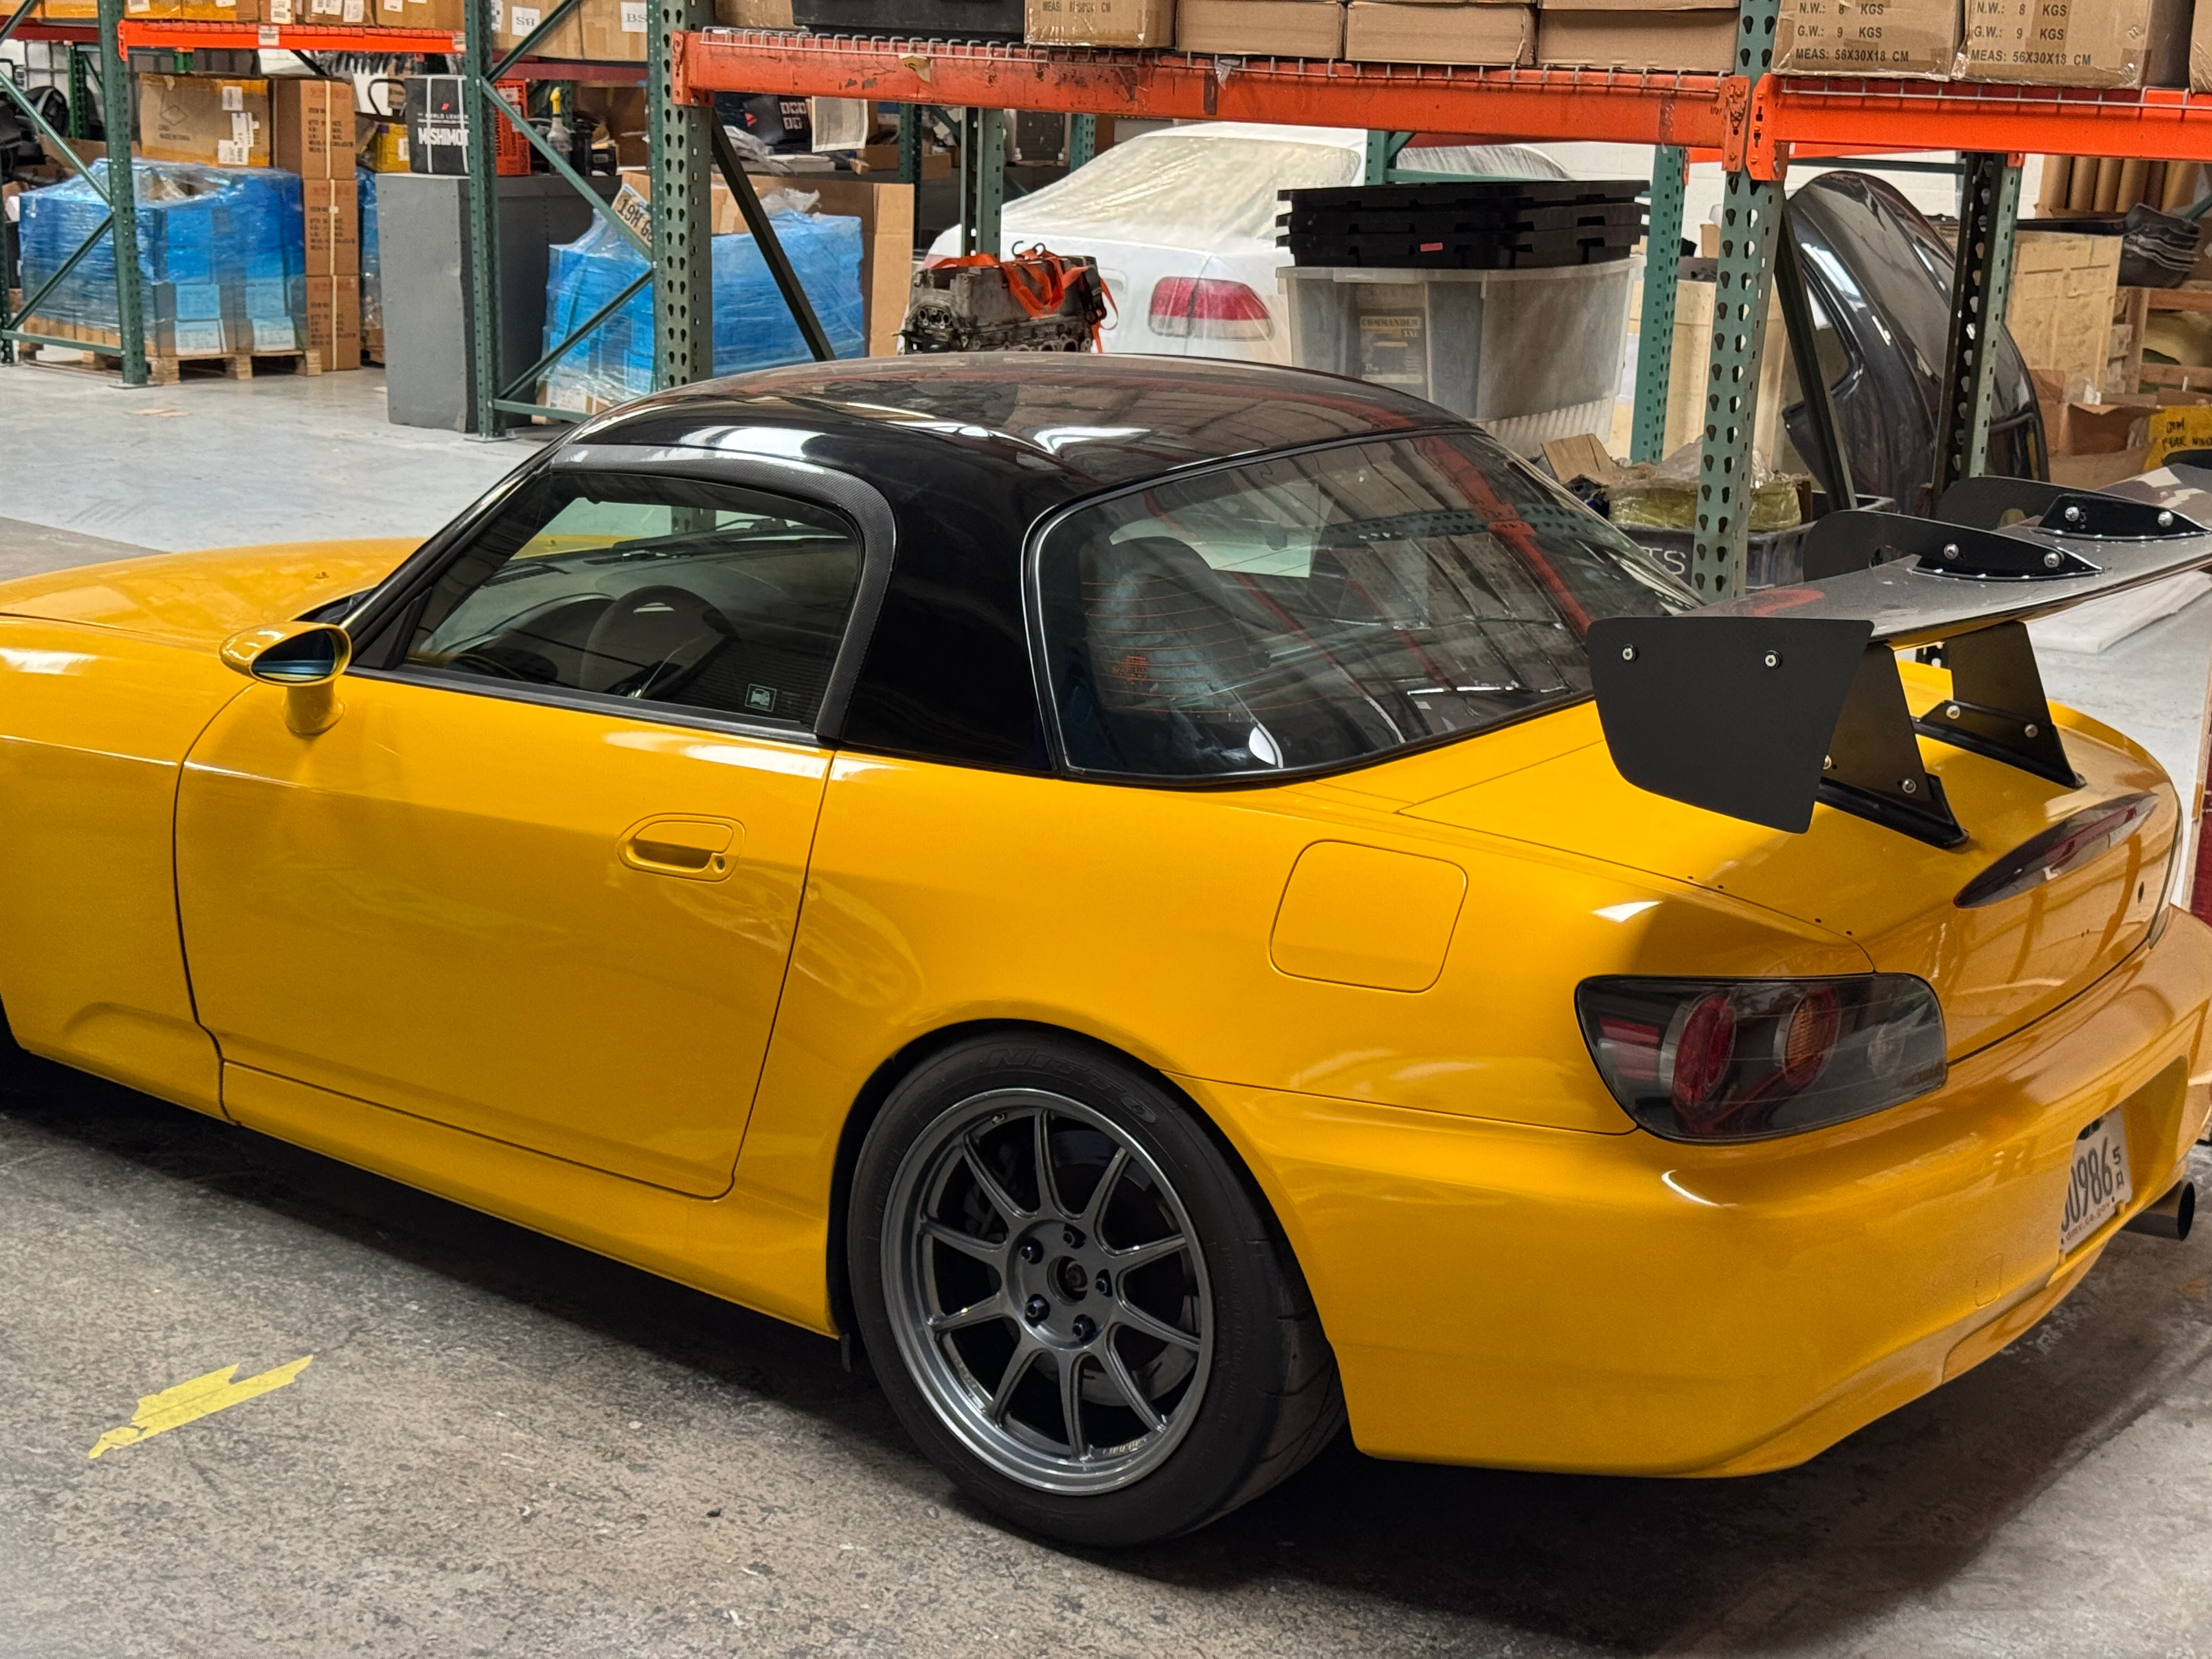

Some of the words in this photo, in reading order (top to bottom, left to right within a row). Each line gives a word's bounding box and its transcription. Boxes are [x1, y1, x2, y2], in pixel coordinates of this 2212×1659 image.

[1838, 4, 1844, 15] 8
[1860, 3, 1884, 15] KGS
[2019, 4, 2025, 15] 8
[2042, 4, 2067, 17] KGS
[1797, 25, 1824, 37] G.W.:
[1837, 26, 1843, 38] 9
[1859, 26, 1882, 38] KGS
[1974, 26, 2002, 38] G.W.:
[2016, 28, 2023, 40] 9
[2040, 29, 2064, 41] KGS
[1796, 48, 1829, 60] MEAS:
[1834, 49, 1886, 61] 56X30X18
[1892, 50, 1909, 62] CM
[1971, 49, 2006, 62] MEAS:
[2012, 51, 2067, 65] 56X30X18
[2073, 54, 2091, 66] CM
[417, 127, 470, 146] MSHIMOT
[986, 1047, 1157, 1124] NITTO
